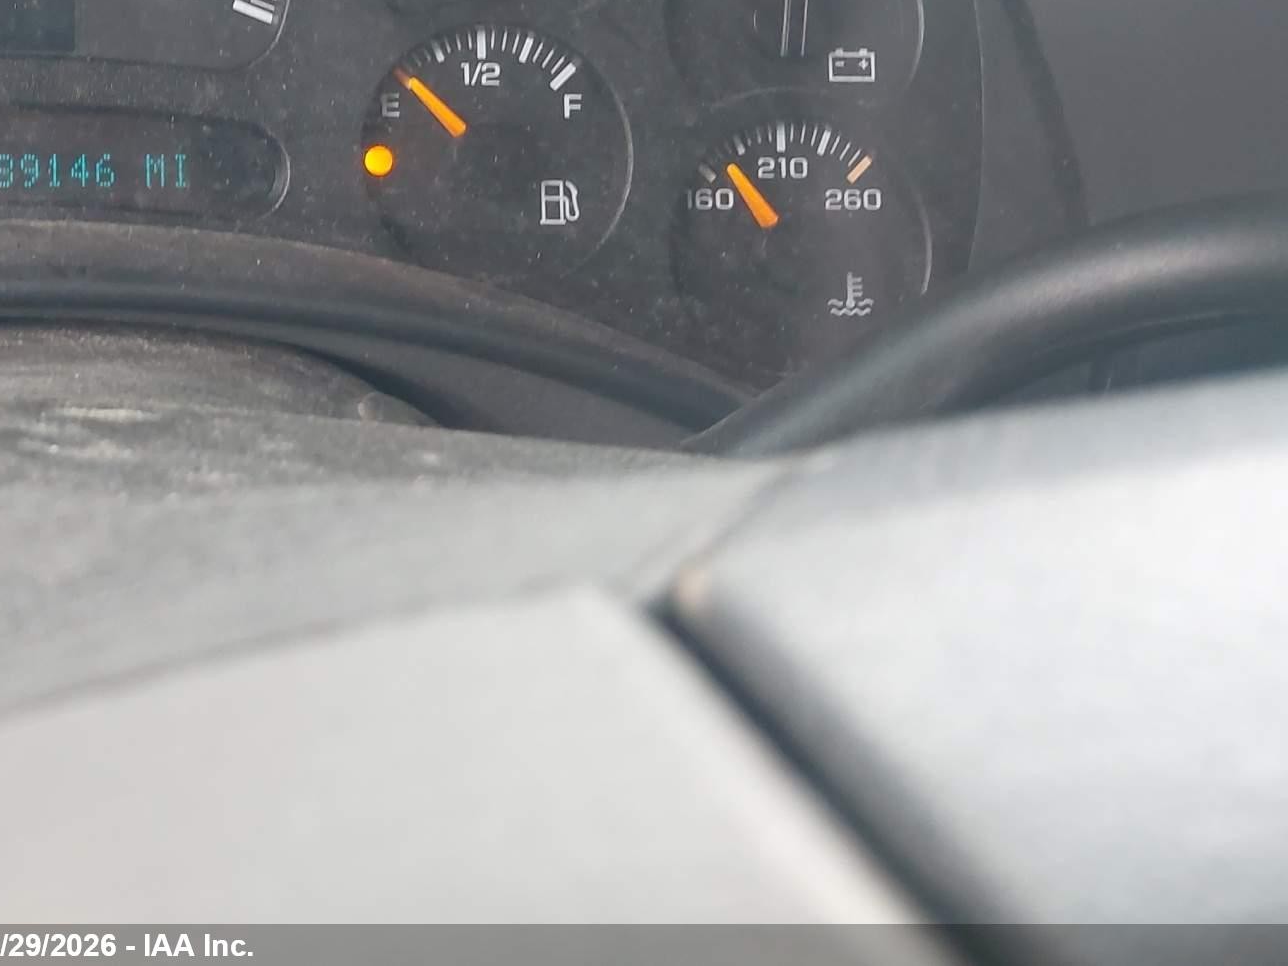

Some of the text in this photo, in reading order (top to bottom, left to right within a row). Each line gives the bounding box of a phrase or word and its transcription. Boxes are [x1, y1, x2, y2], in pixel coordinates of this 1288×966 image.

[461, 63, 500, 85] 1/2
[381, 93, 400, 117] E
[564, 94, 581, 118] F
[145, 154, 187, 188] MI
[758, 158, 807, 178] 210
[687, 189, 733, 209] 160
[826, 189, 881, 210] 260
